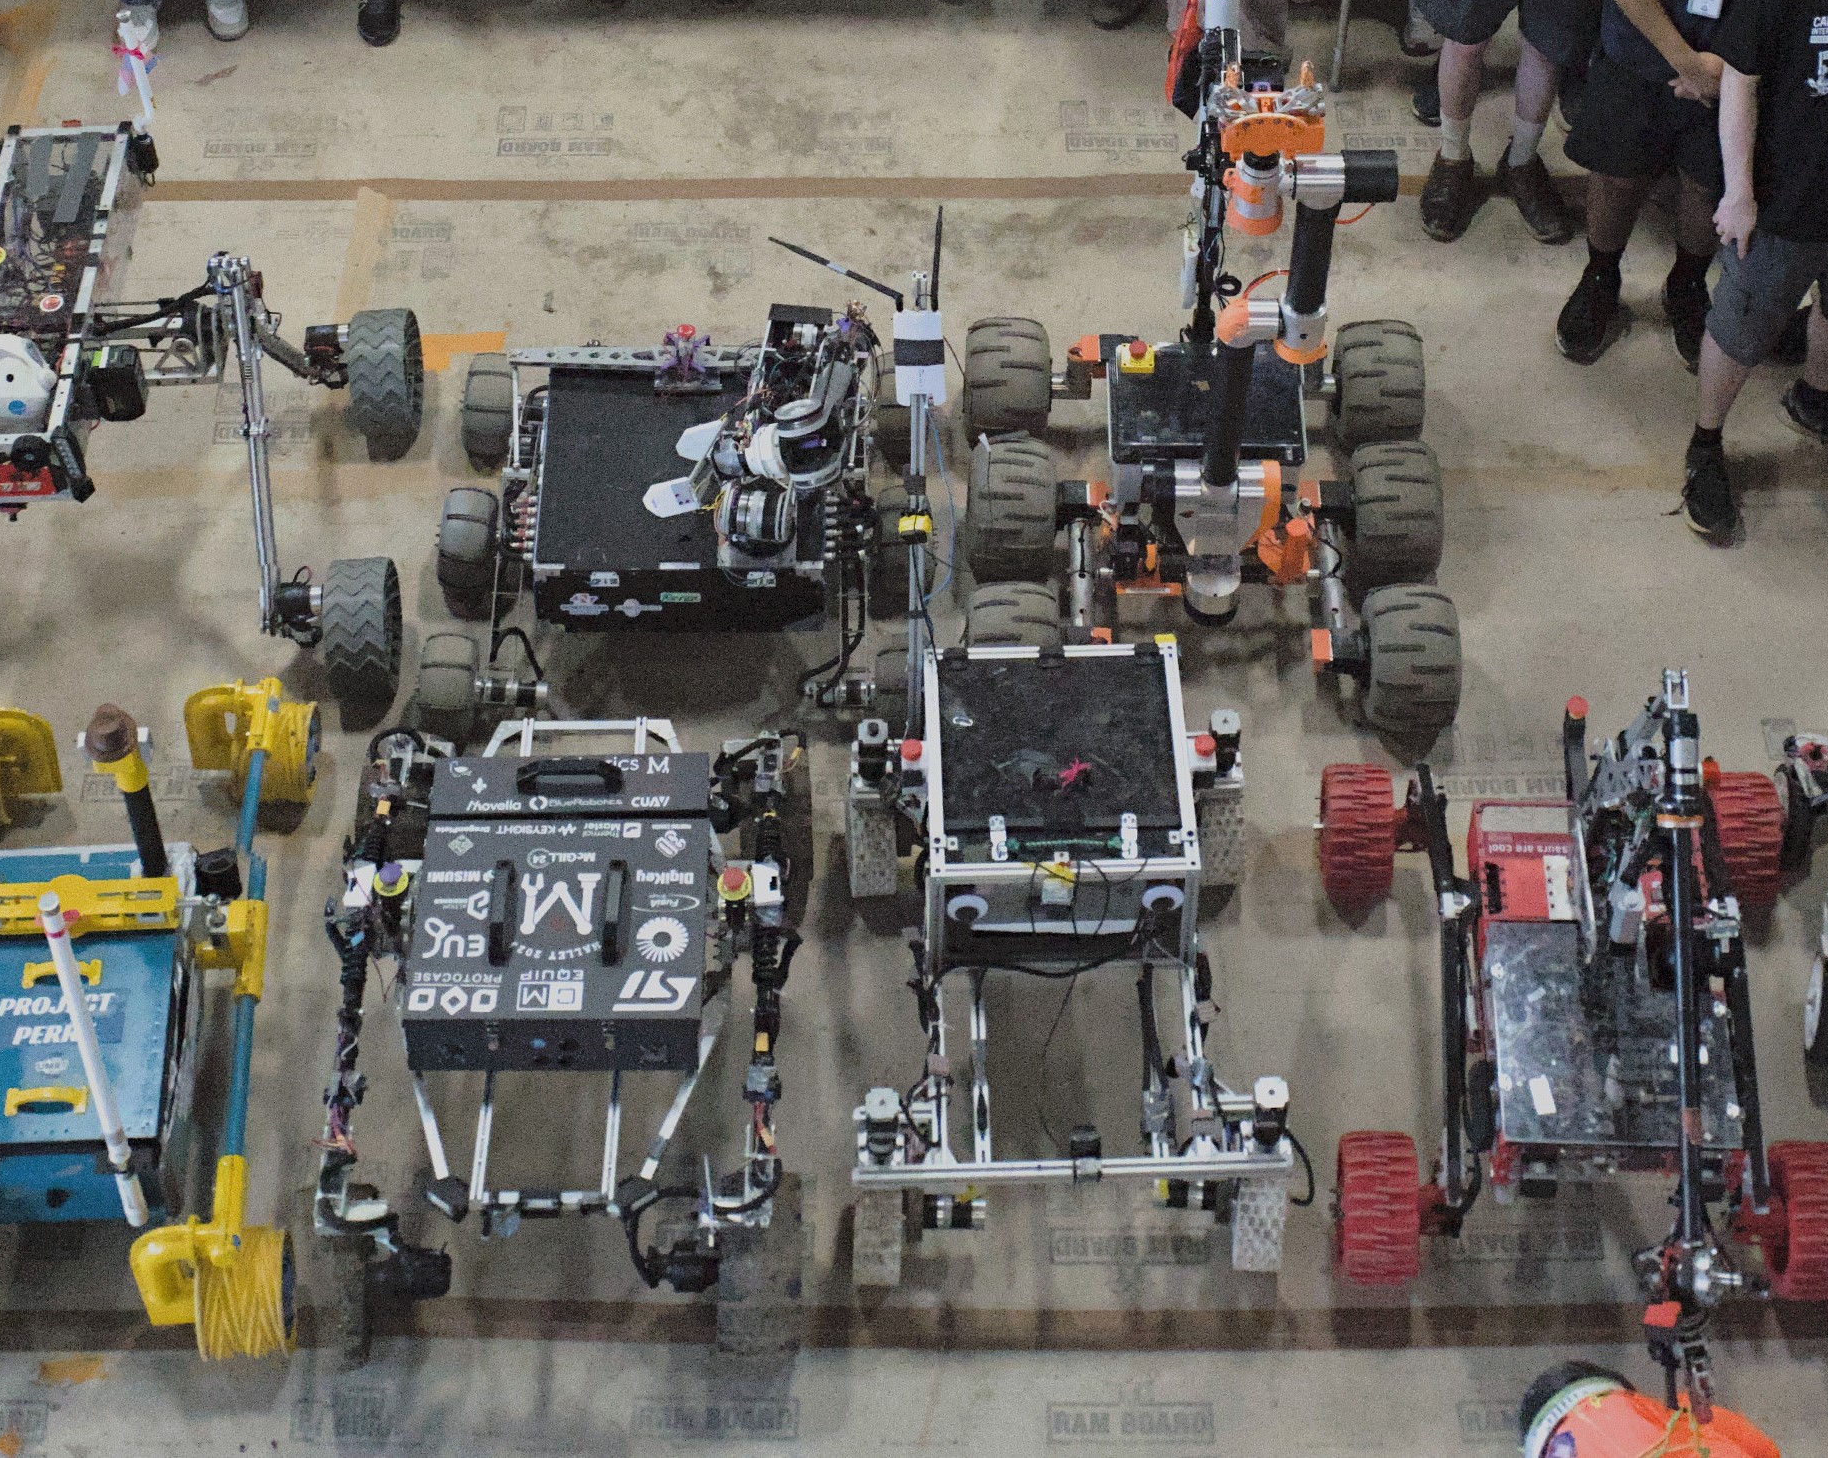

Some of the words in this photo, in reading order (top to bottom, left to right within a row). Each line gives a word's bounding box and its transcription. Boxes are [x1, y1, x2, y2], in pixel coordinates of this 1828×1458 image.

[495, 824, 557, 835] KEYSIGHT
[427, 870, 481, 883] MISUMI
[636, 869, 694, 884] DigiKey
[413, 972, 502, 984] PROTOCASE
[520, 969, 584, 981] EQUIP
[12, 1024, 97, 1047] PERR
